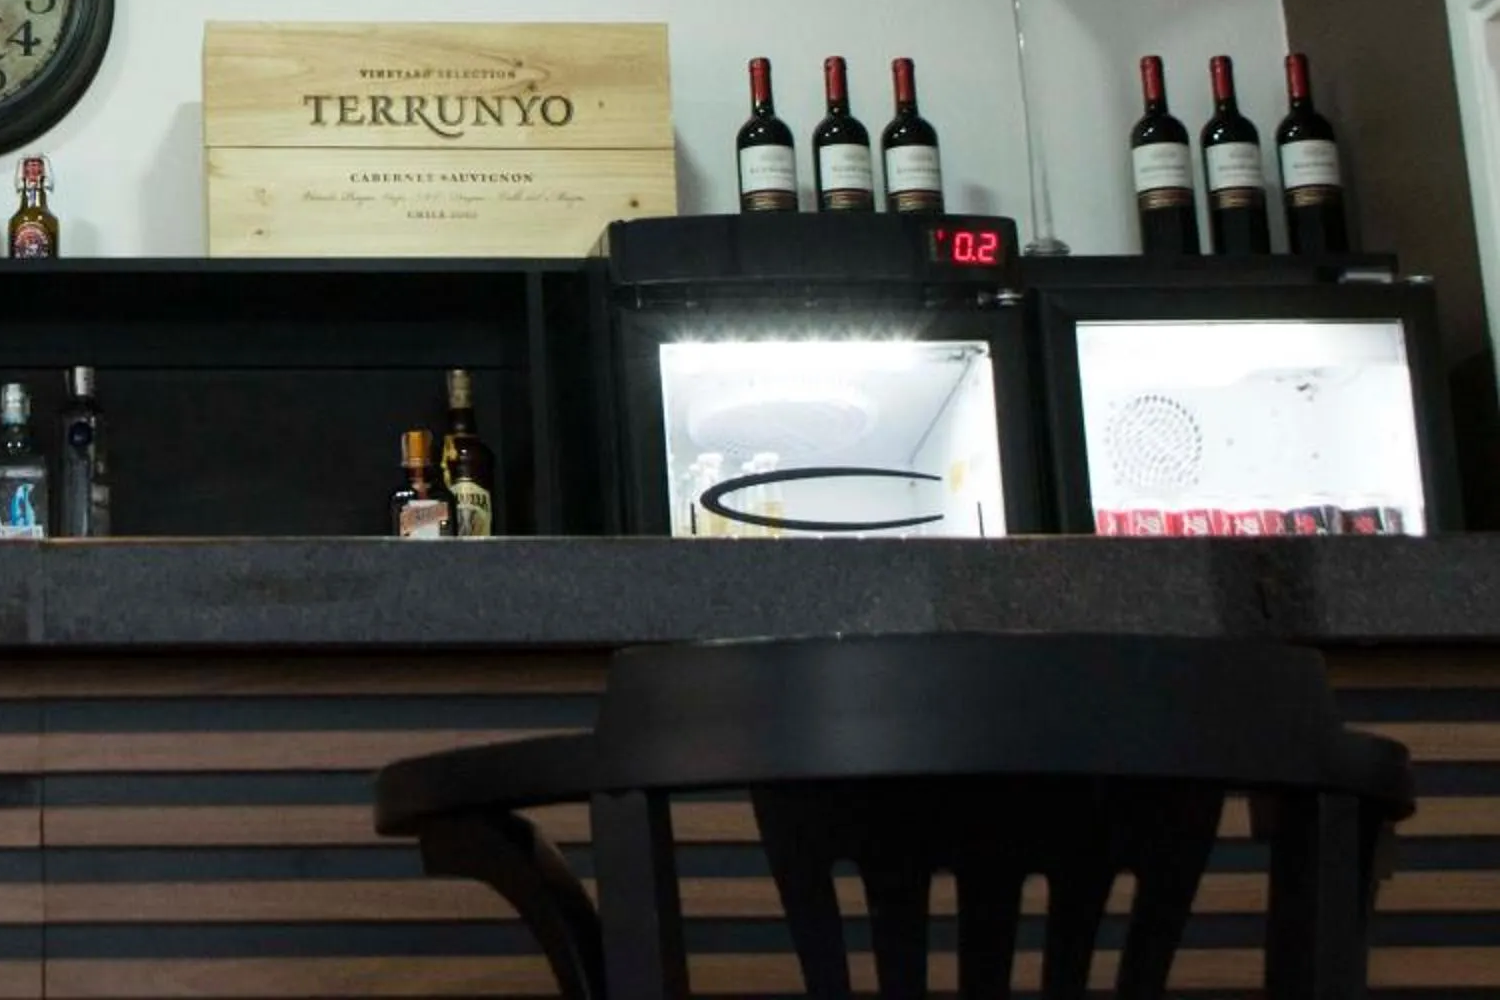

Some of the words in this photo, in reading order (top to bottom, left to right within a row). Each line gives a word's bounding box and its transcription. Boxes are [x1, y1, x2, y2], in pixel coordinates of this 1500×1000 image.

[6, 20, 41, 57] 4
[303, 95, 574, 138] TERRUNYO
[350, 173, 434, 182] CABERNET
